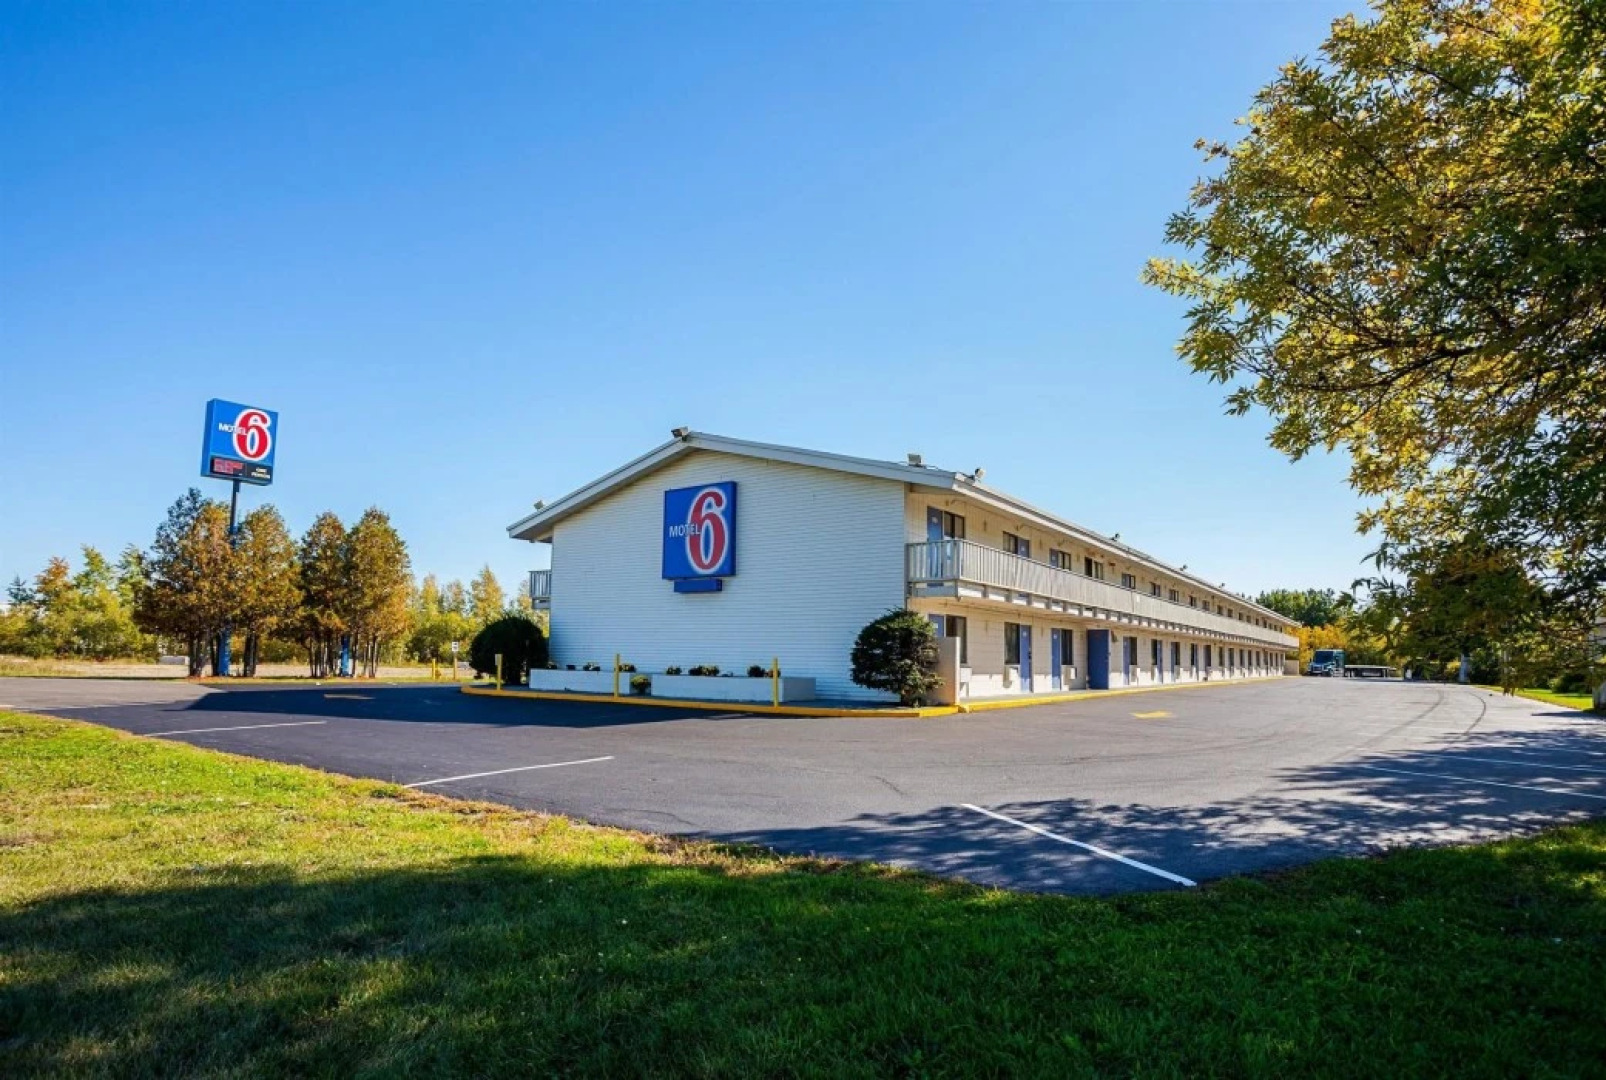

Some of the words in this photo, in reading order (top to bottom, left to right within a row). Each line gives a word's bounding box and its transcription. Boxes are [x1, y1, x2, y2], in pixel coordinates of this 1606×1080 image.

[234, 409, 271, 460] 6
[669, 525, 701, 537] MOTEL
[686, 488, 728, 574] 6
